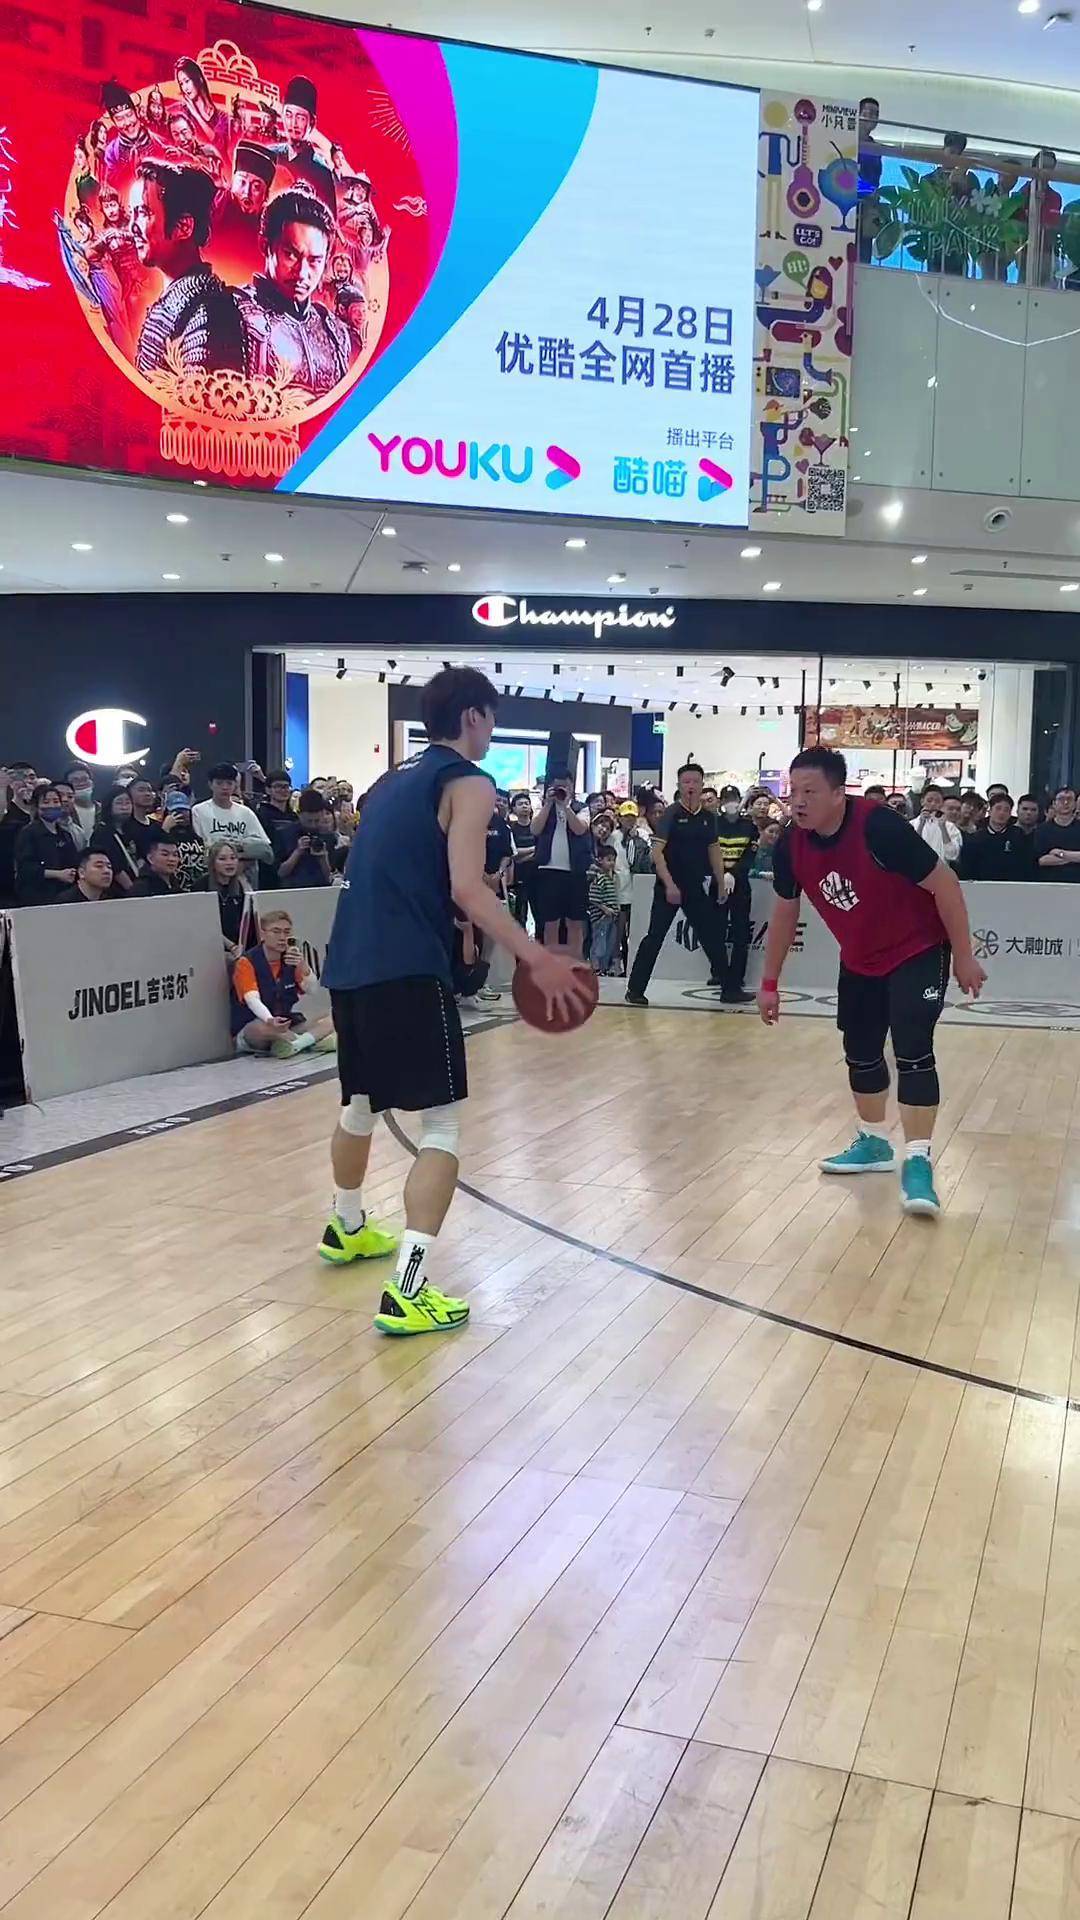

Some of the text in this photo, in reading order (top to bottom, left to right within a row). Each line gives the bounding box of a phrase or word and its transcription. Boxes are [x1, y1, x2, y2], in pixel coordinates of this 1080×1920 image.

[587, 295, 733, 346] 4月28日
[495, 331, 736, 394] 优酷全网首播
[368, 433, 533, 483] YOUKU
[666, 427, 735, 450] 播出平台
[613, 456, 688, 497] 酷喵
[472, 595, 676, 639] Champion
[1006, 936, 1063, 955] 大融城
[69, 973, 188, 1020] JINOEL 吉诺尔
